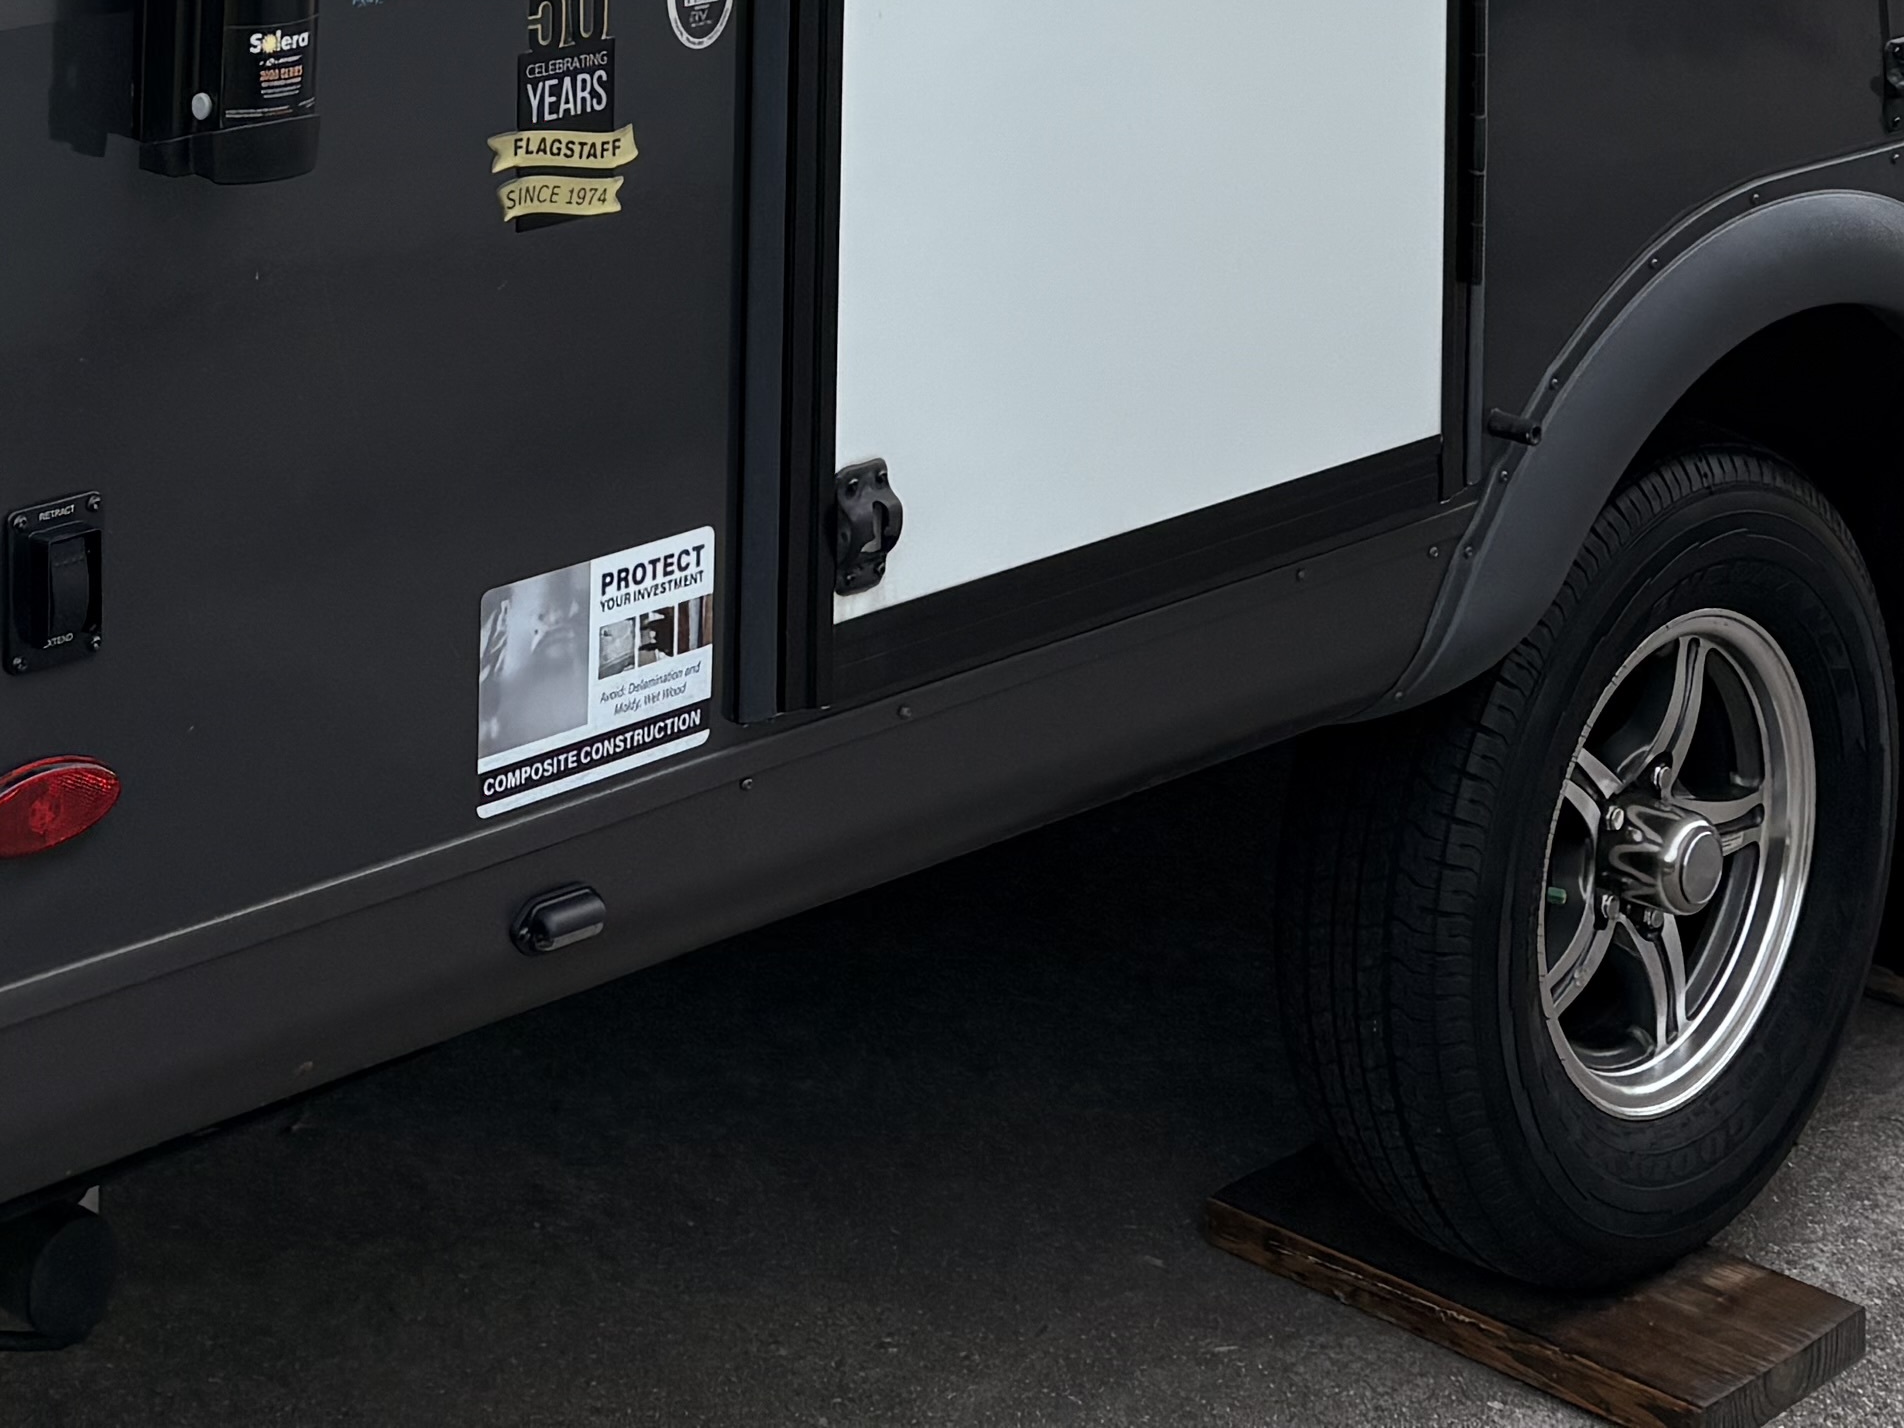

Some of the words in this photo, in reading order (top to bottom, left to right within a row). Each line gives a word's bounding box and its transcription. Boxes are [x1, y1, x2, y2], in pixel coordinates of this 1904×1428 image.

[525, 50, 609, 79] CELEBRATING
[526, 69, 608, 124] YEARS
[513, 136, 622, 160] FLAGSTAFF
[505, 184, 560, 211] SINCE
[565, 186, 609, 207] 1974
[600, 543, 705, 596] PROTECT
[600, 590, 632, 613] YOUR
[633, 570, 704, 603] INVESTMENT
[684, 660, 702, 677] and
[483, 752, 578, 797] COMPOSITE
[580, 708, 702, 764] CONSTRUCTION
